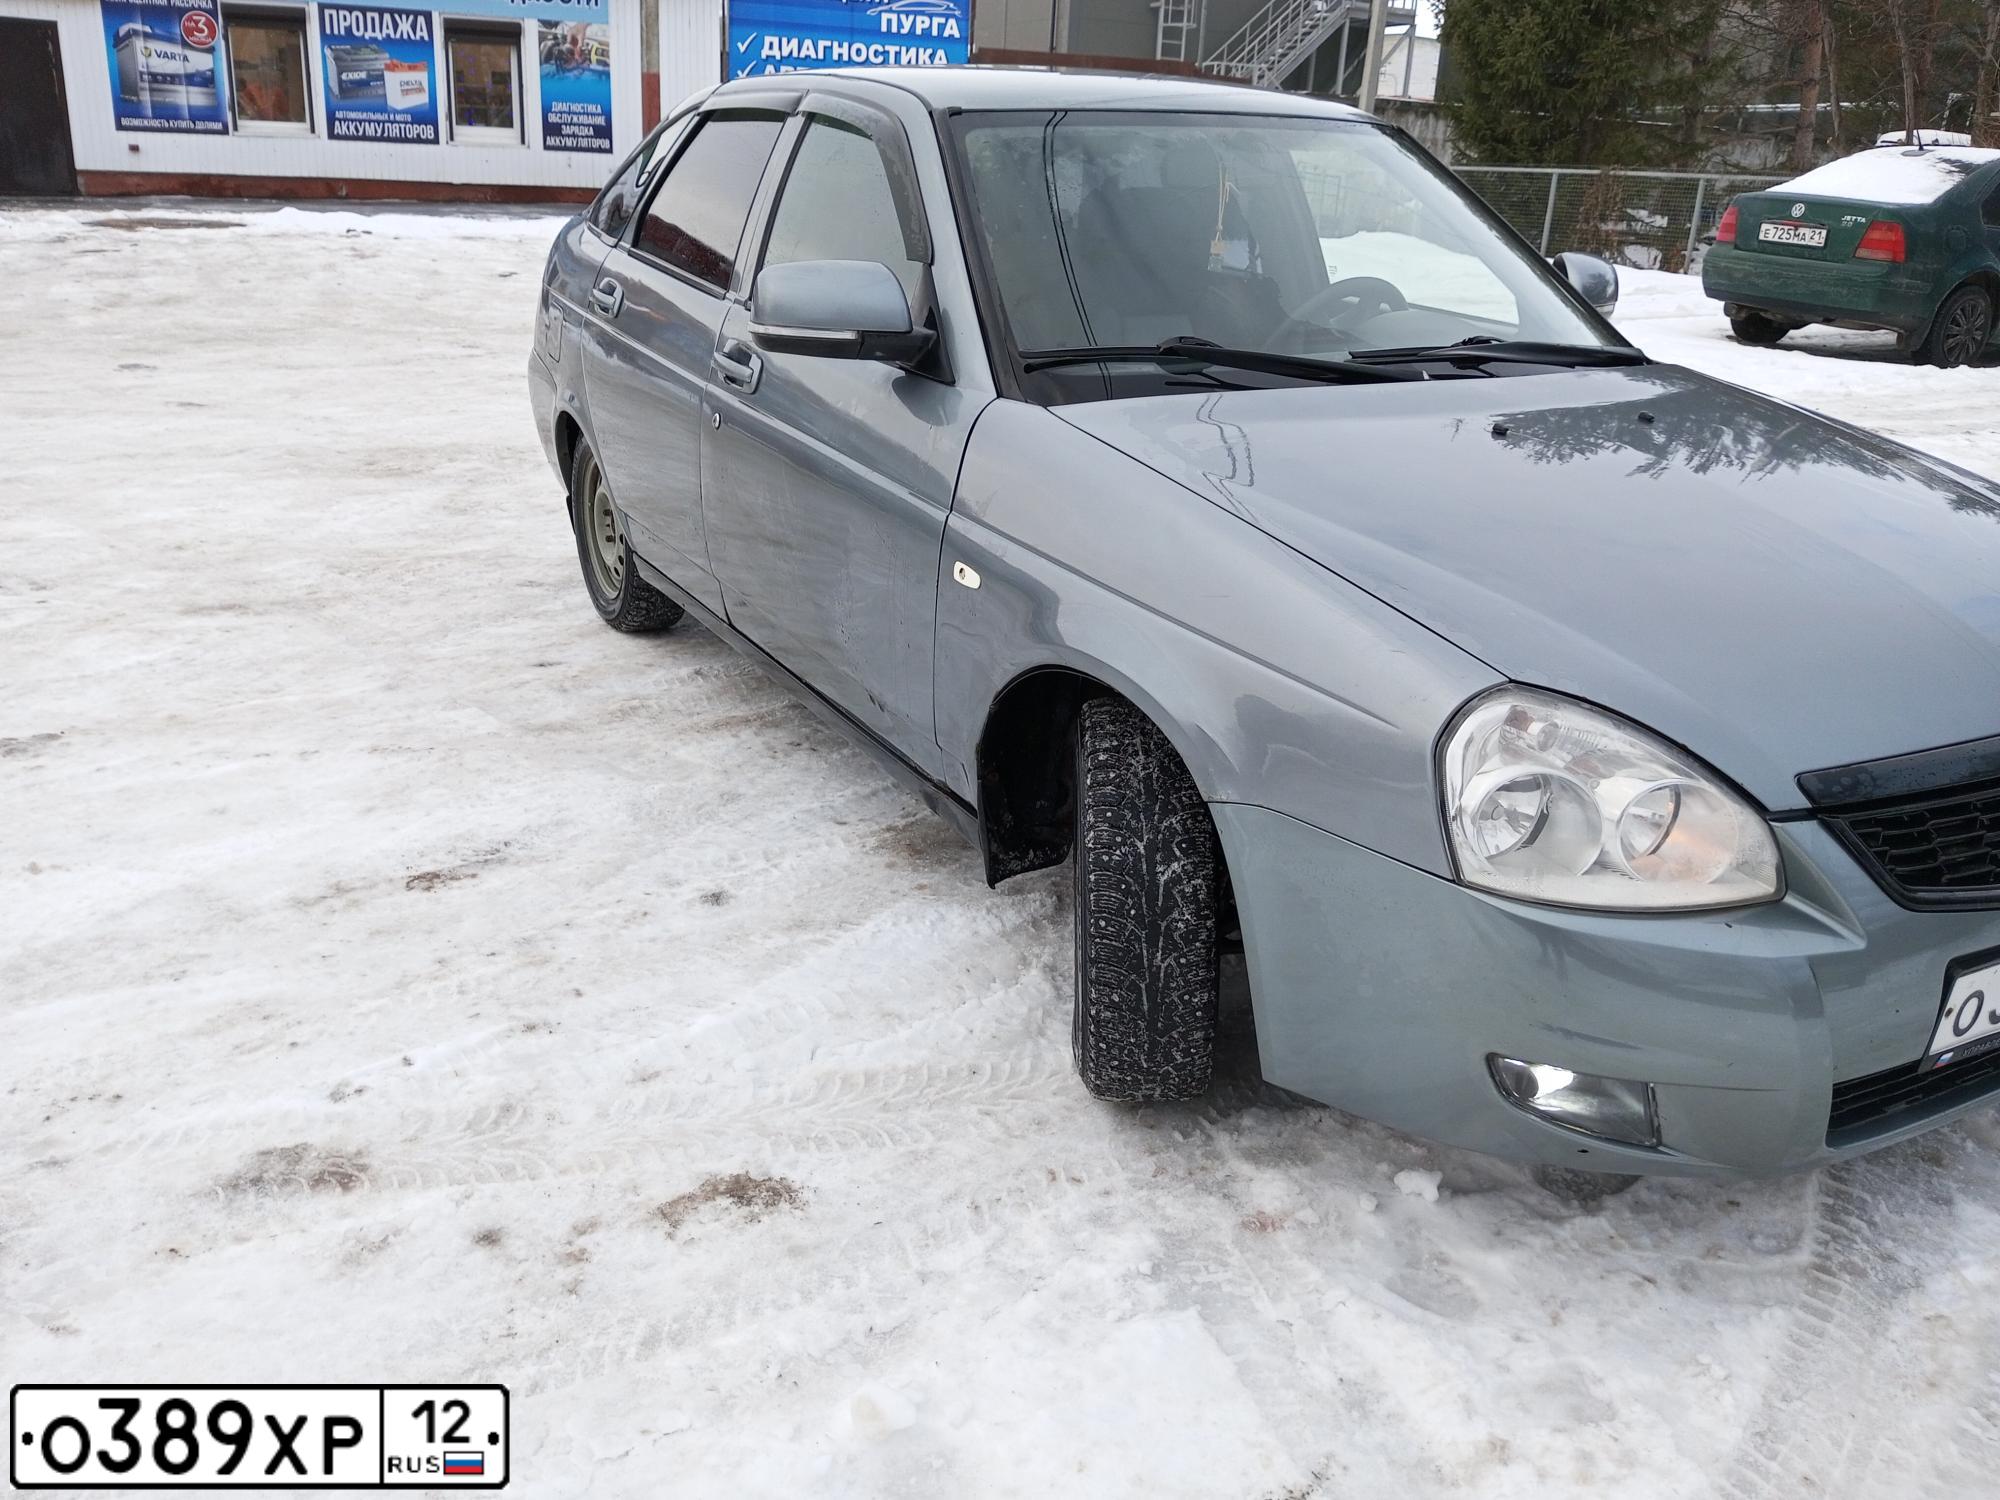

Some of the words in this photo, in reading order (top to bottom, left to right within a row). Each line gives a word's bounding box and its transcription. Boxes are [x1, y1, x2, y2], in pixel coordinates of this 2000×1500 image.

[192, 16, 208, 36] 3
[324, 9, 429, 41] ПРОДАЖА
[881, 13, 961, 38] ПУРГА
[154, 49, 190, 63] VARTA
[761, 36, 948, 64] ДИАГНОСТИКА
[551, 102, 602, 113] ДИАГНОСТИКА
[335, 110, 388, 121] АВТОМОБИЛЬНЫХ
[390, 112, 395, 121] И
[396, 113, 412, 122] МОТО
[548, 113, 606, 125] ОБСЛУЖИВАНИЕ
[121, 117, 169, 128] ВОЗМОЖНОСТЬ
[170, 119, 195, 129] КУПИТЬ
[334, 120, 435, 139] АККУМУЛЯТОРОВ
[561, 125, 594, 136] ЗАРЯДКА
[546, 136, 611, 148] АККУМУЛЯТОРОВ
[1841, 215, 1866, 223] JETTA
[1809, 229, 1823, 241] 21
[1953, 990, 2000, 1037] О
